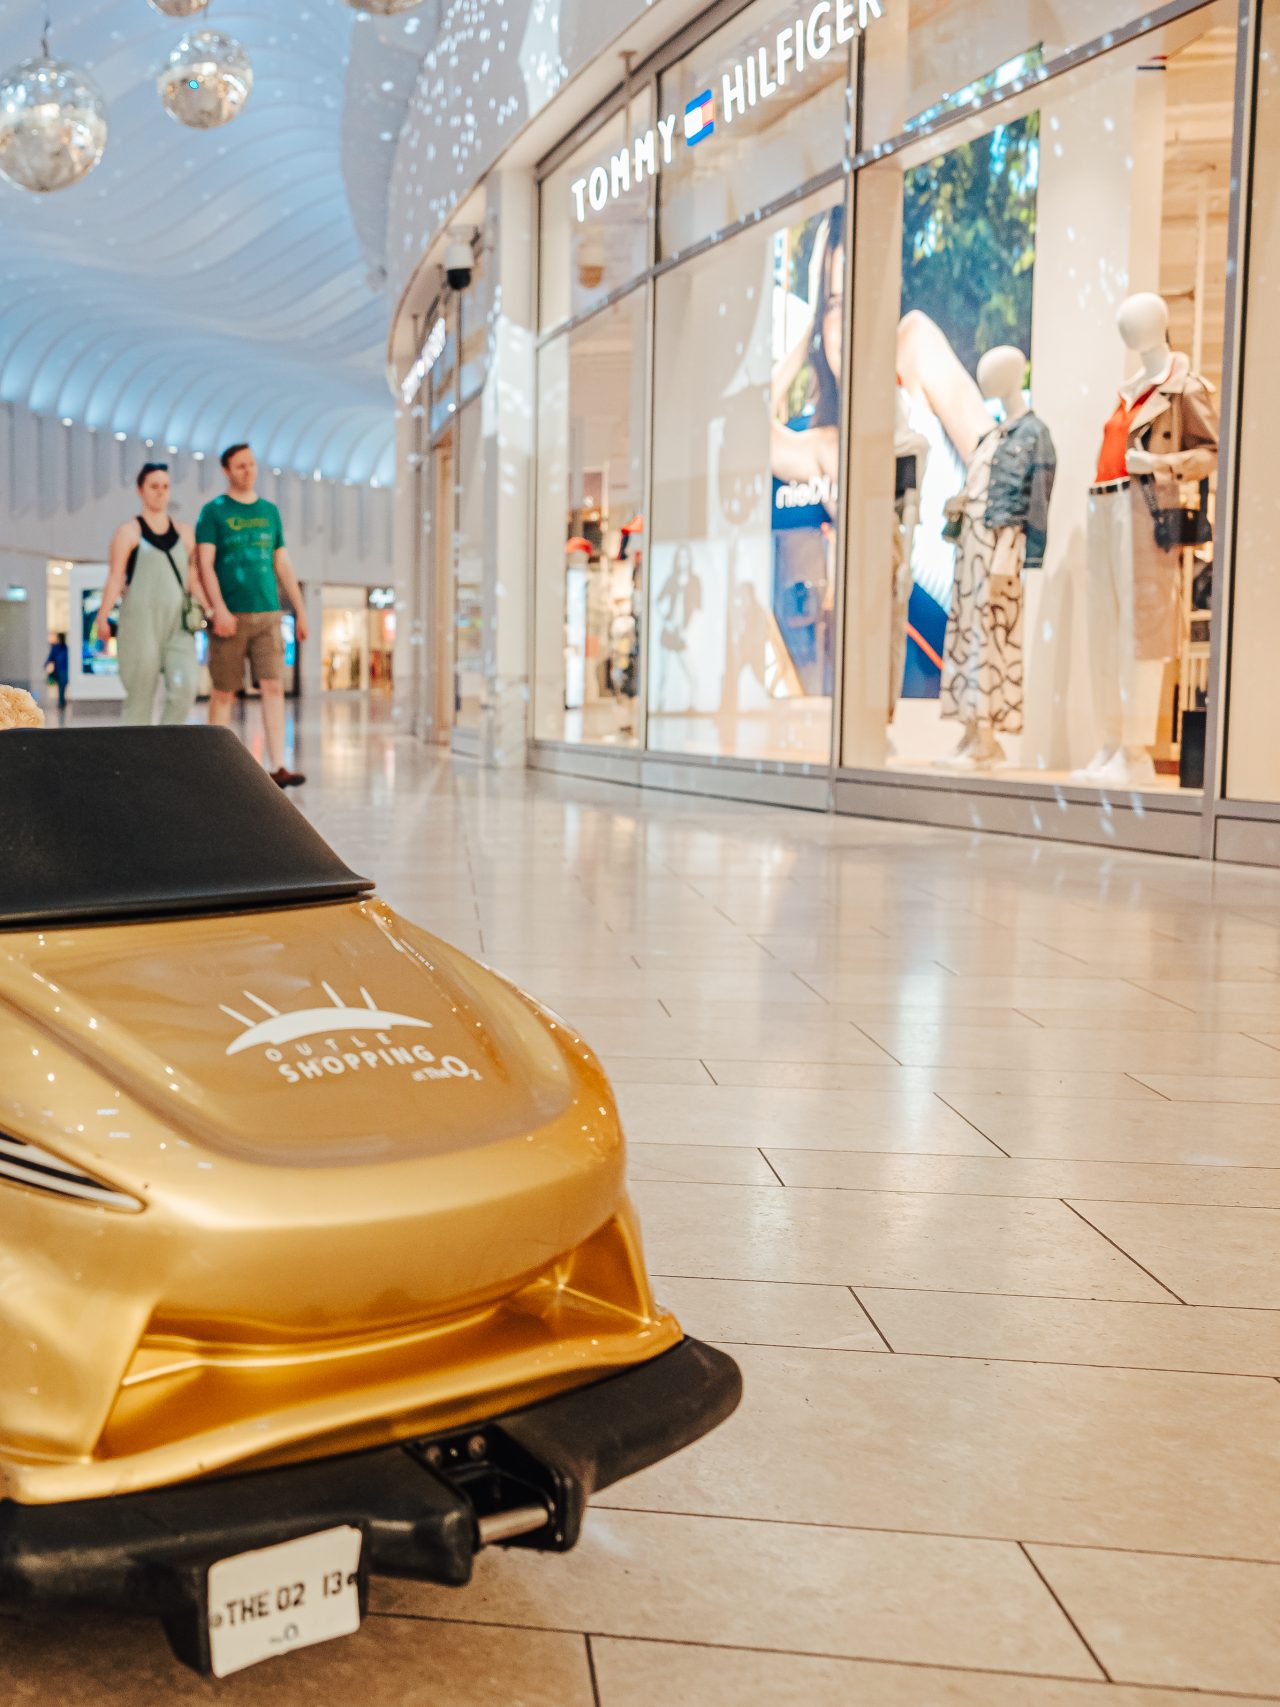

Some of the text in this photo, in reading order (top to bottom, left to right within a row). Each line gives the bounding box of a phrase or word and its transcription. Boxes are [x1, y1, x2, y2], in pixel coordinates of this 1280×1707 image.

[571, 113, 676, 223] TOMMY
[278, 1045, 436, 1083] SHOPPING
[226, 1592, 270, 1627] THE
[323, 1571, 343, 1600] 13
